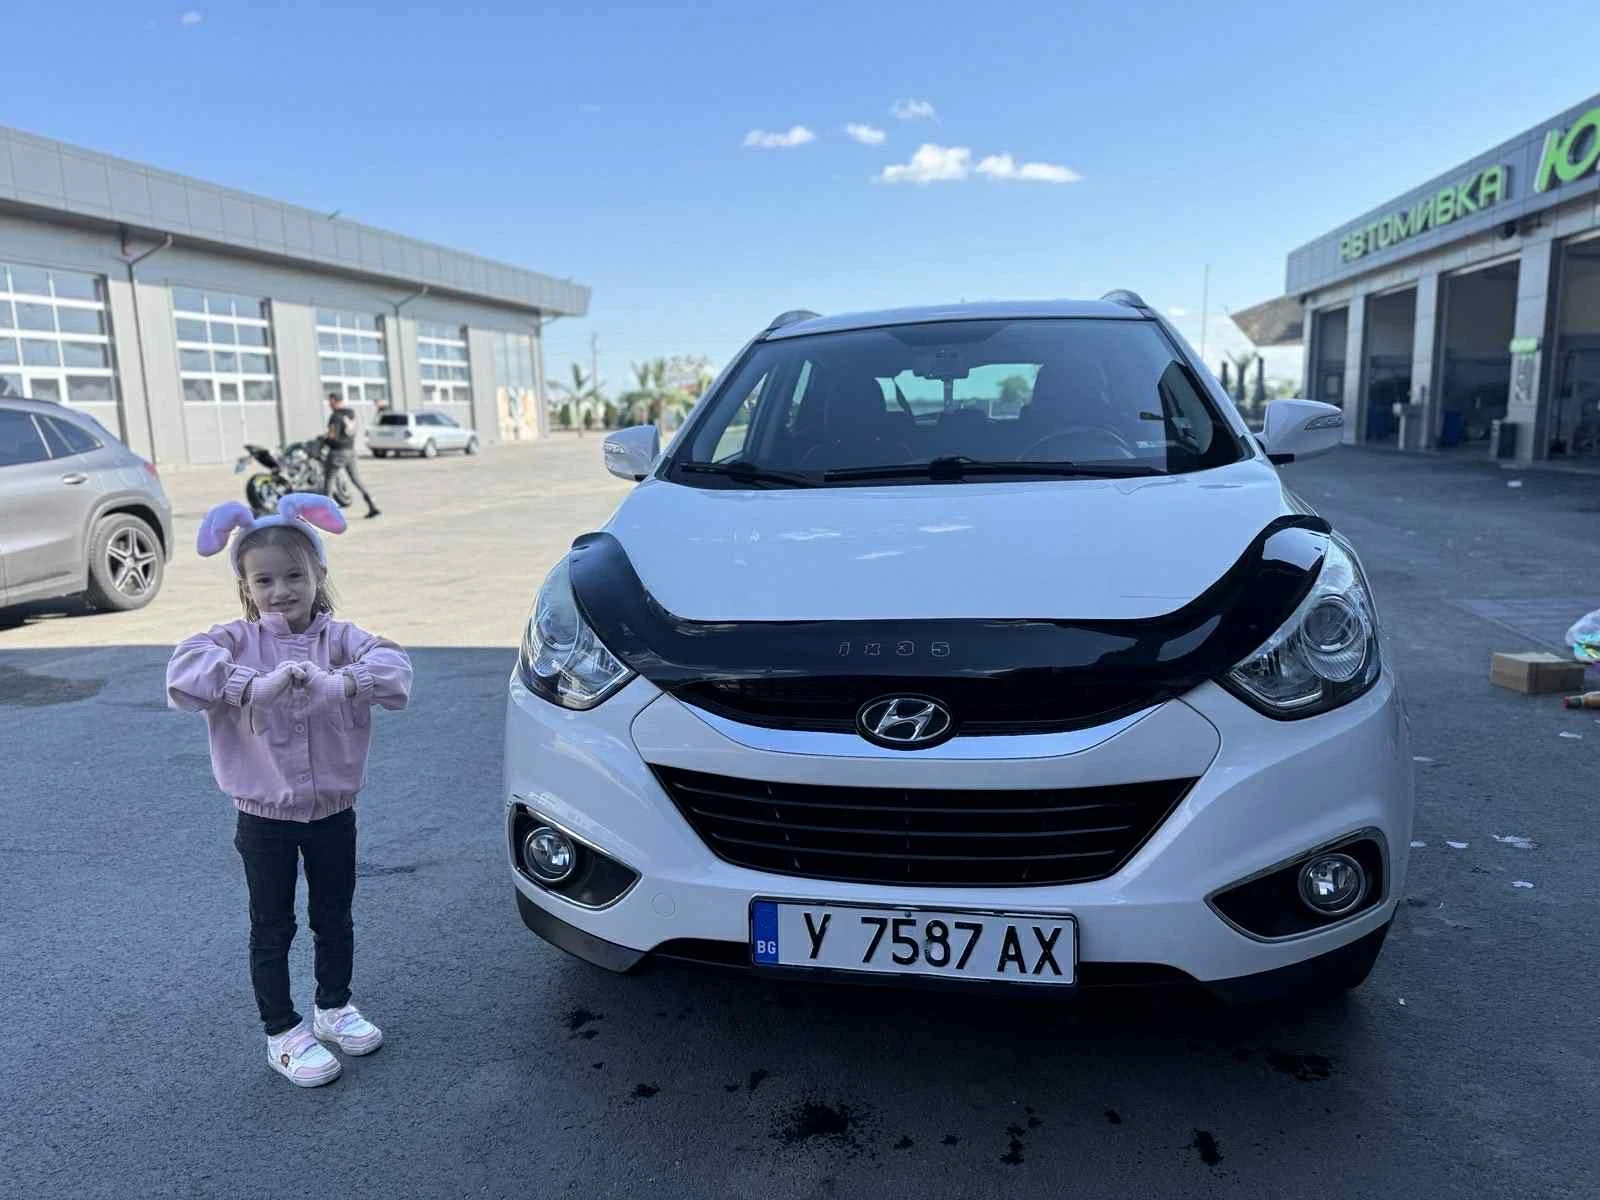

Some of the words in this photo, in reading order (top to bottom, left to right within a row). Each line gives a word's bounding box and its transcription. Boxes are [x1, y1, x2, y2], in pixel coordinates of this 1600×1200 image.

[1340, 165, 1505, 263] АВТОМИВКА
[756, 939, 777, 955] BG
[860, 916, 983, 970] 7587
[996, 925, 1063, 976] AX
